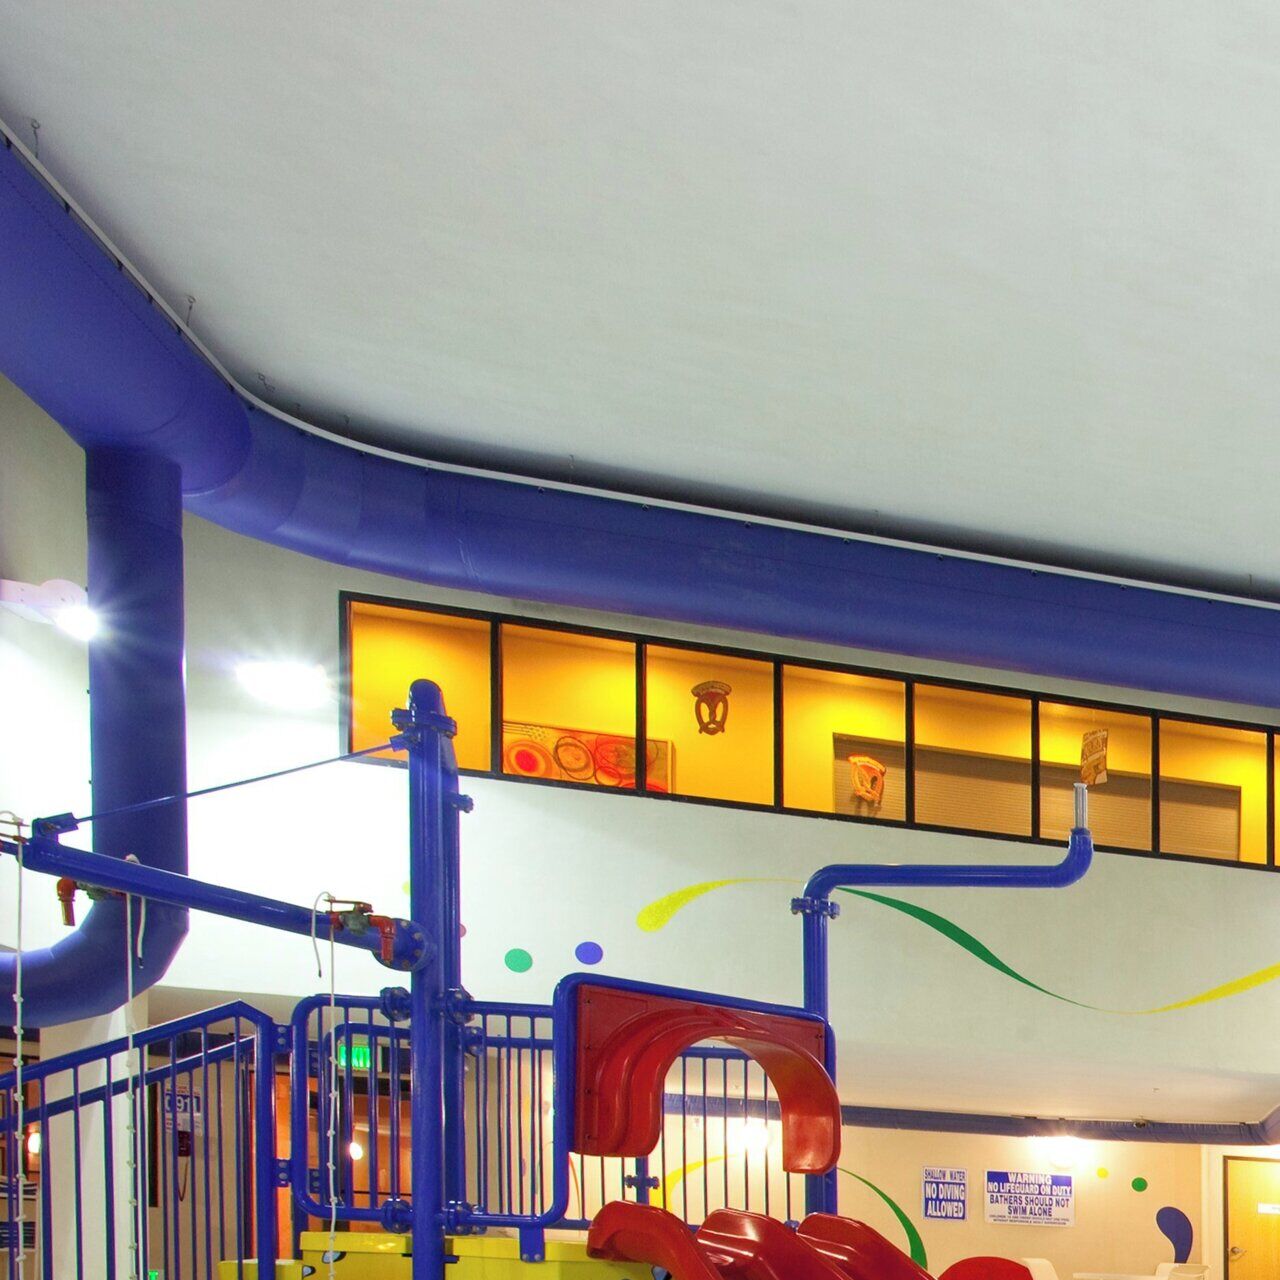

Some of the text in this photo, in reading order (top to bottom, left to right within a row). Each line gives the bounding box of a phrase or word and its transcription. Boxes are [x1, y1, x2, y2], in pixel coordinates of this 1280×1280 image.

[924, 1169, 966, 1181] SHALLOW WATER
[1007, 1172, 1053, 1185] WARNING
[925, 1183, 965, 1200] NO DIVING
[987, 1182, 1072, 1196] NO LIFEGUARD ON DUTY
[989, 1194, 1070, 1208] BATHERS SHOULD NOT
[927, 1201, 964, 1218] ALLOWED
[1007, 1205, 1052, 1217] SWIM ALONE
